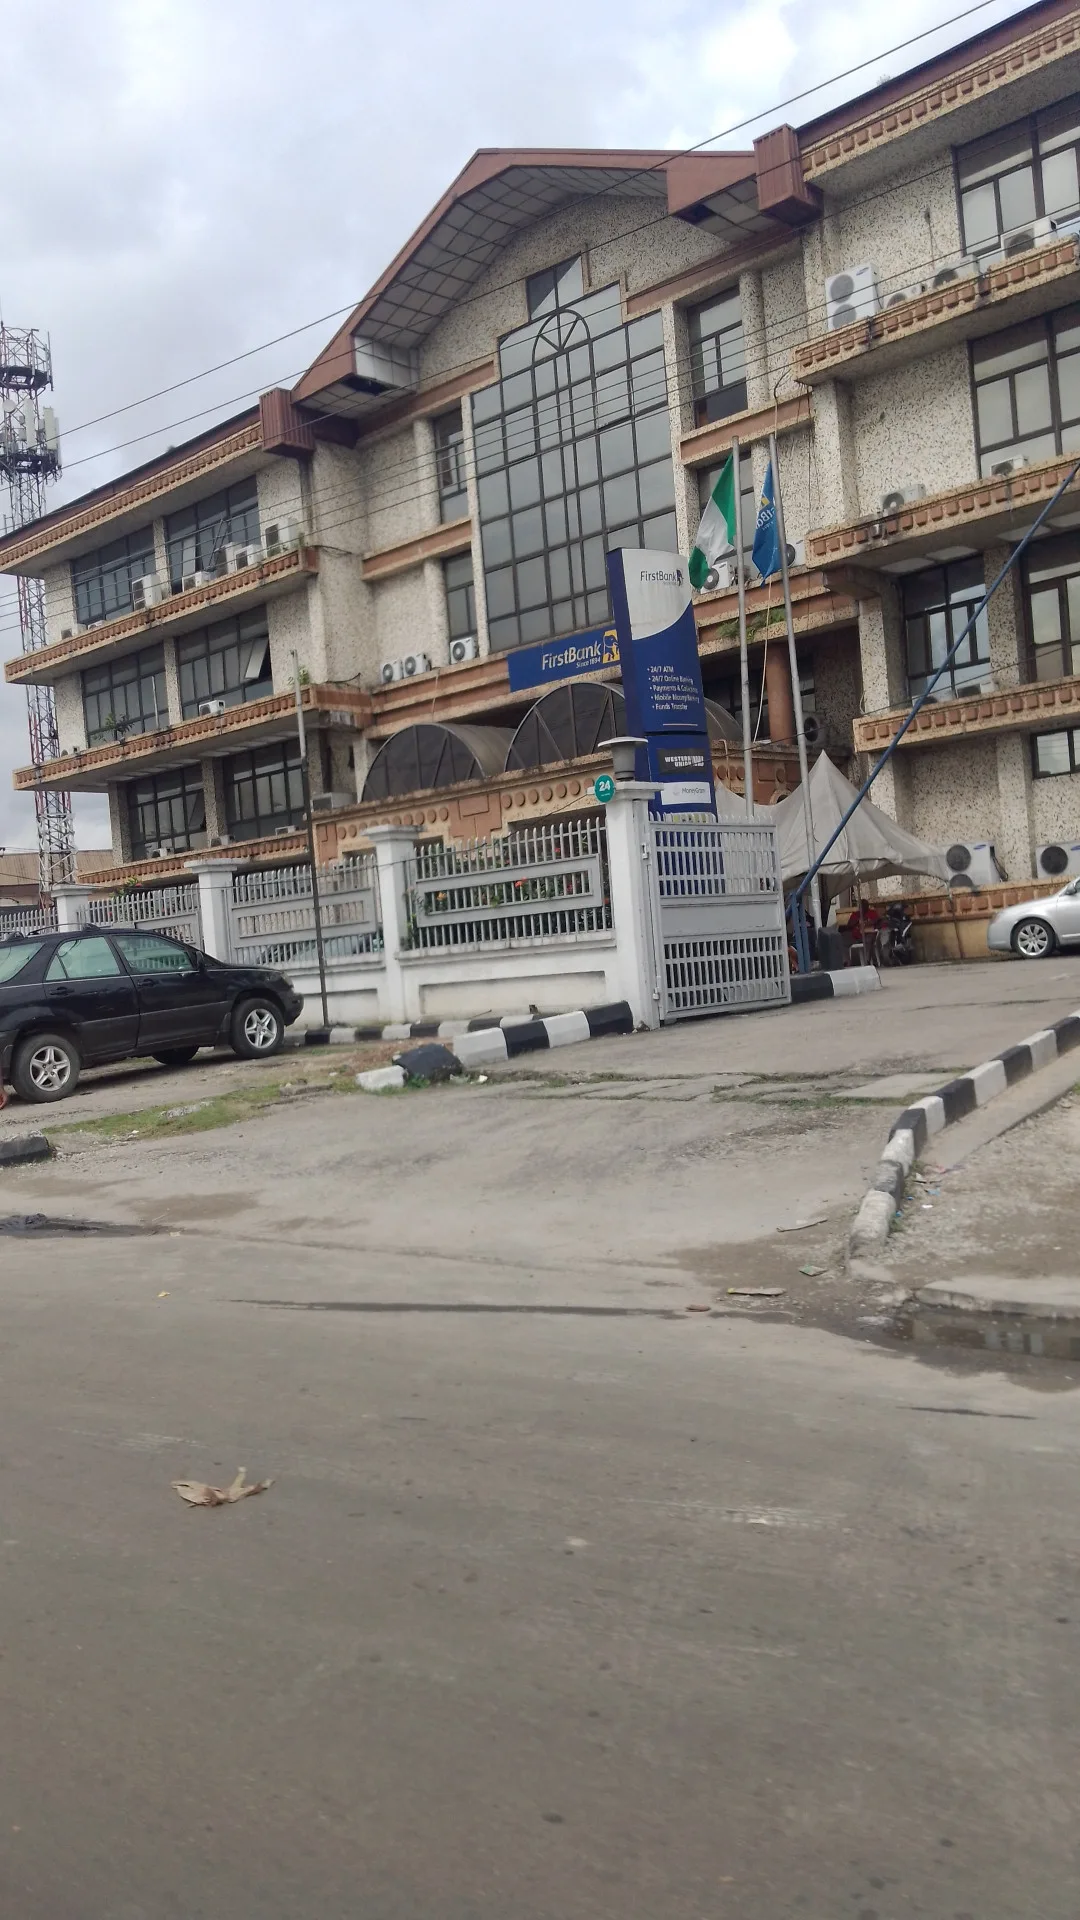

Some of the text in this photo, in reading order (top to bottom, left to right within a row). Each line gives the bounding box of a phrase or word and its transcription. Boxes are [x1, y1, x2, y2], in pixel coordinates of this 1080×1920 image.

[640, 570, 677, 581] FirstBank
[542, 641, 601, 670] FirstBank
[599, 780, 611, 792] 24
